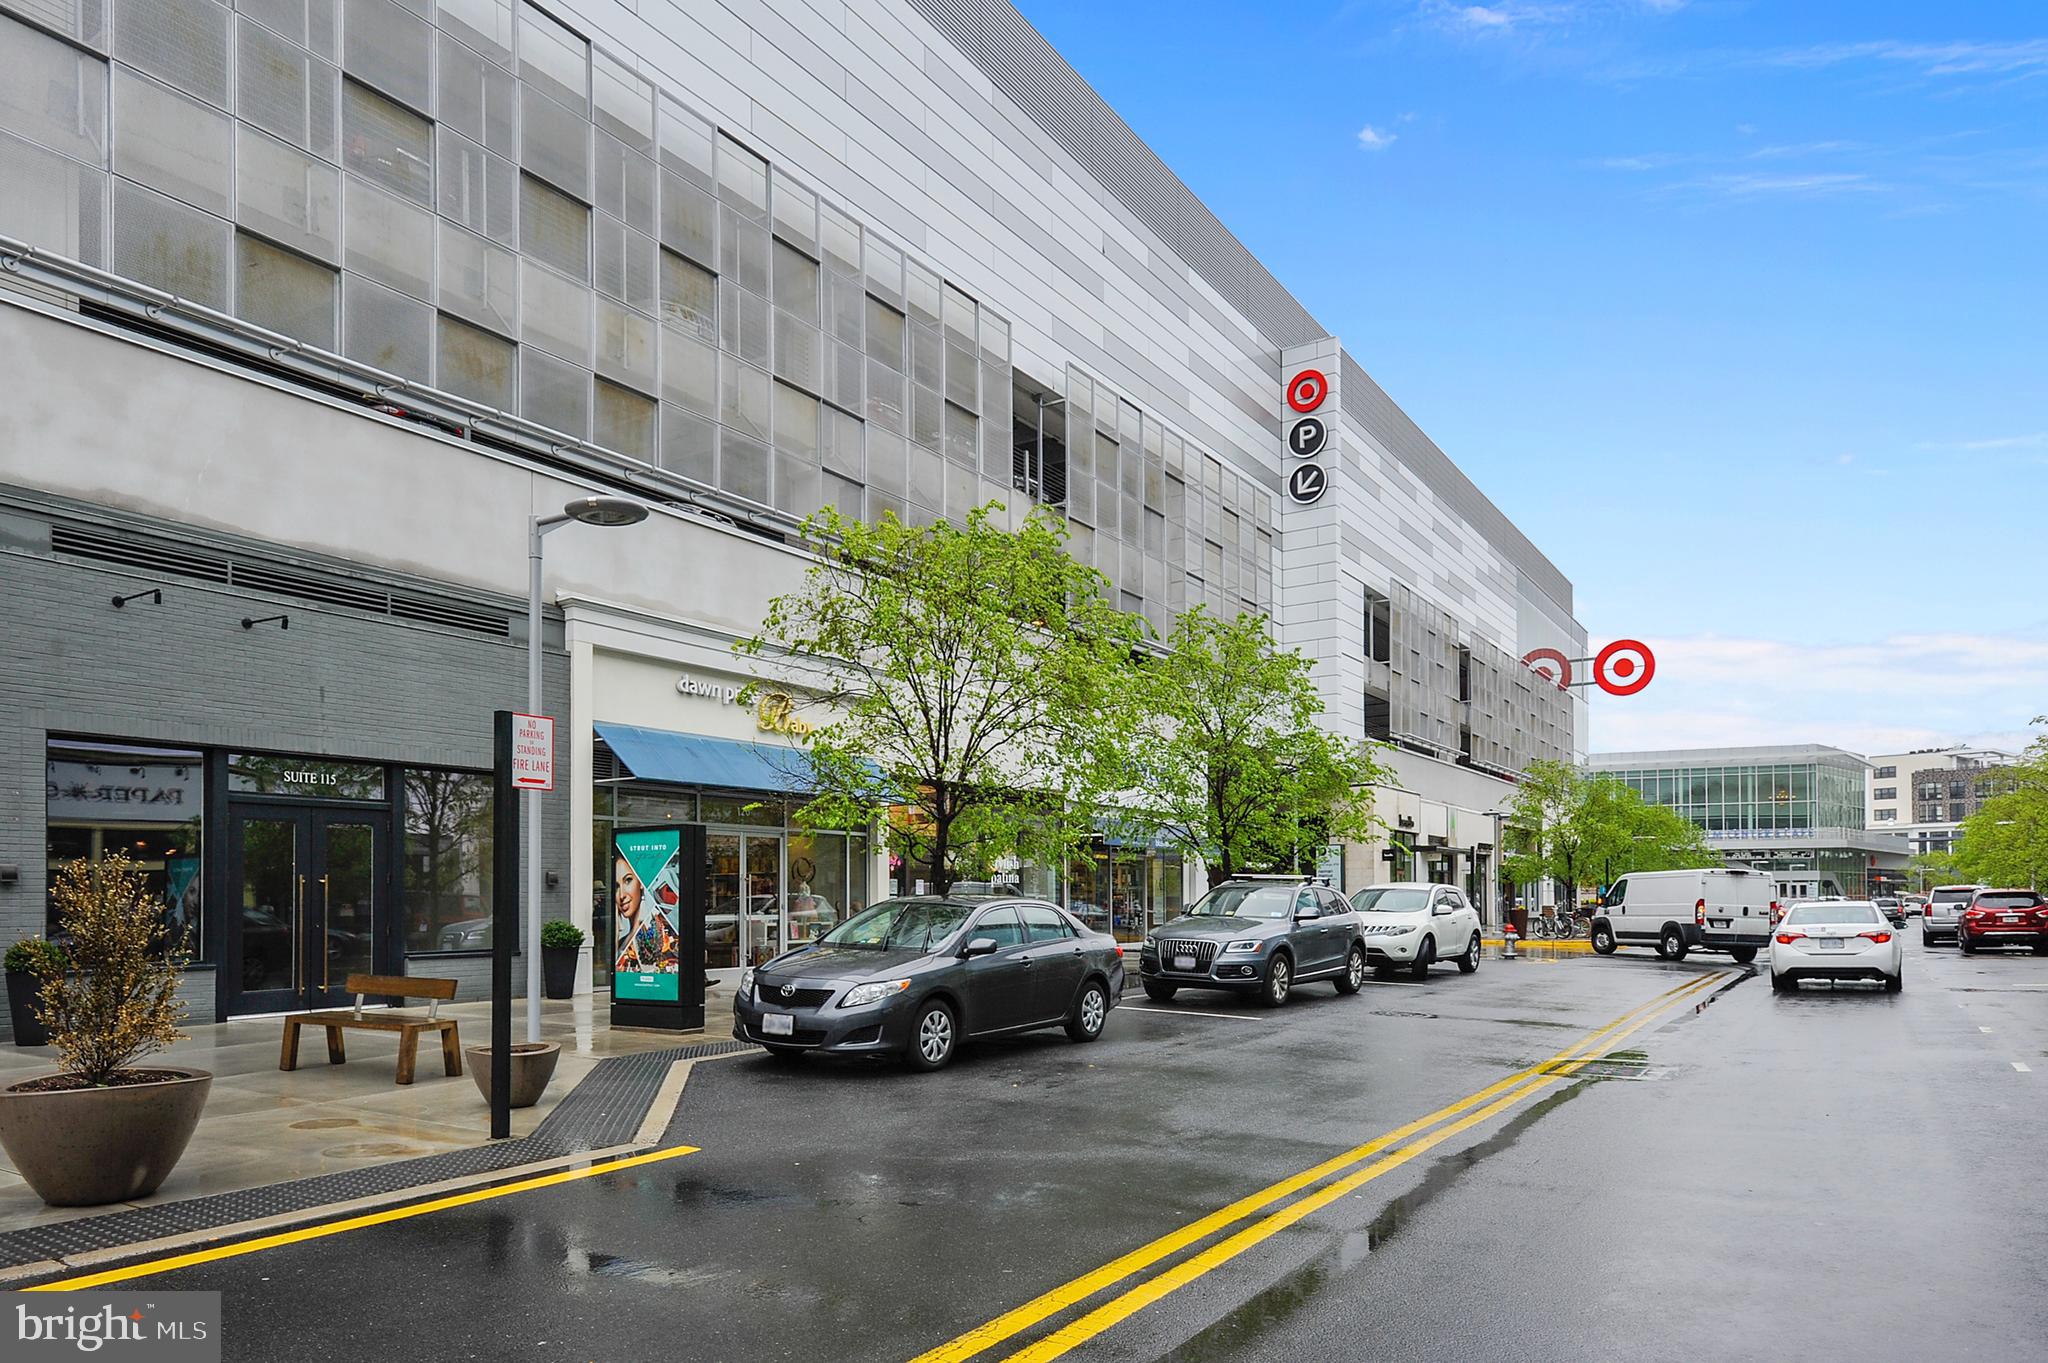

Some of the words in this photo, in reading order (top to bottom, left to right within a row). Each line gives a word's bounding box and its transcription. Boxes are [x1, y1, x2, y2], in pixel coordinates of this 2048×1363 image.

[1299, 424, 1317, 449] P
[677, 673, 721, 698] dawn
[527, 719, 537, 729] NO
[519, 728, 545, 740] PARKING
[516, 744, 546, 756] STANDING
[512, 758, 529, 771] FIRE
[531, 760, 550, 773] LANE
[283, 770, 318, 784] SUITE
[320, 773, 337, 785] 115
[629, 844, 649, 852] STRUT
[991, 870, 1020, 888] patina
